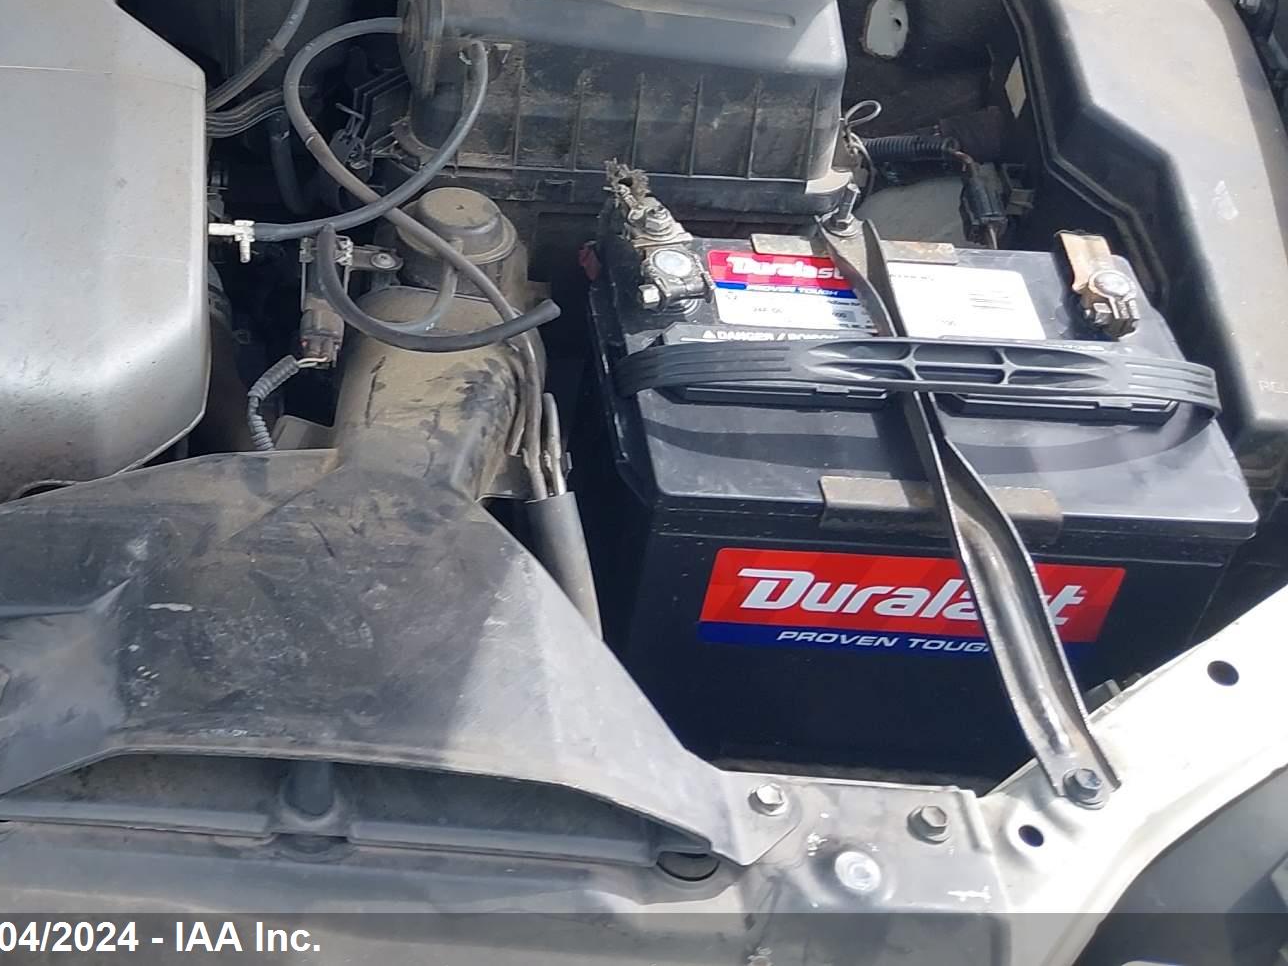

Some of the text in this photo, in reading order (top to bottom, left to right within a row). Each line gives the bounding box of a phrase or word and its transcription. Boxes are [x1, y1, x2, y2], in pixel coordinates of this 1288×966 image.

[716, 330, 775, 342] DANGER
[738, 568, 1085, 626] Duralat
[776, 630, 990, 653] PROVEN TOUG
